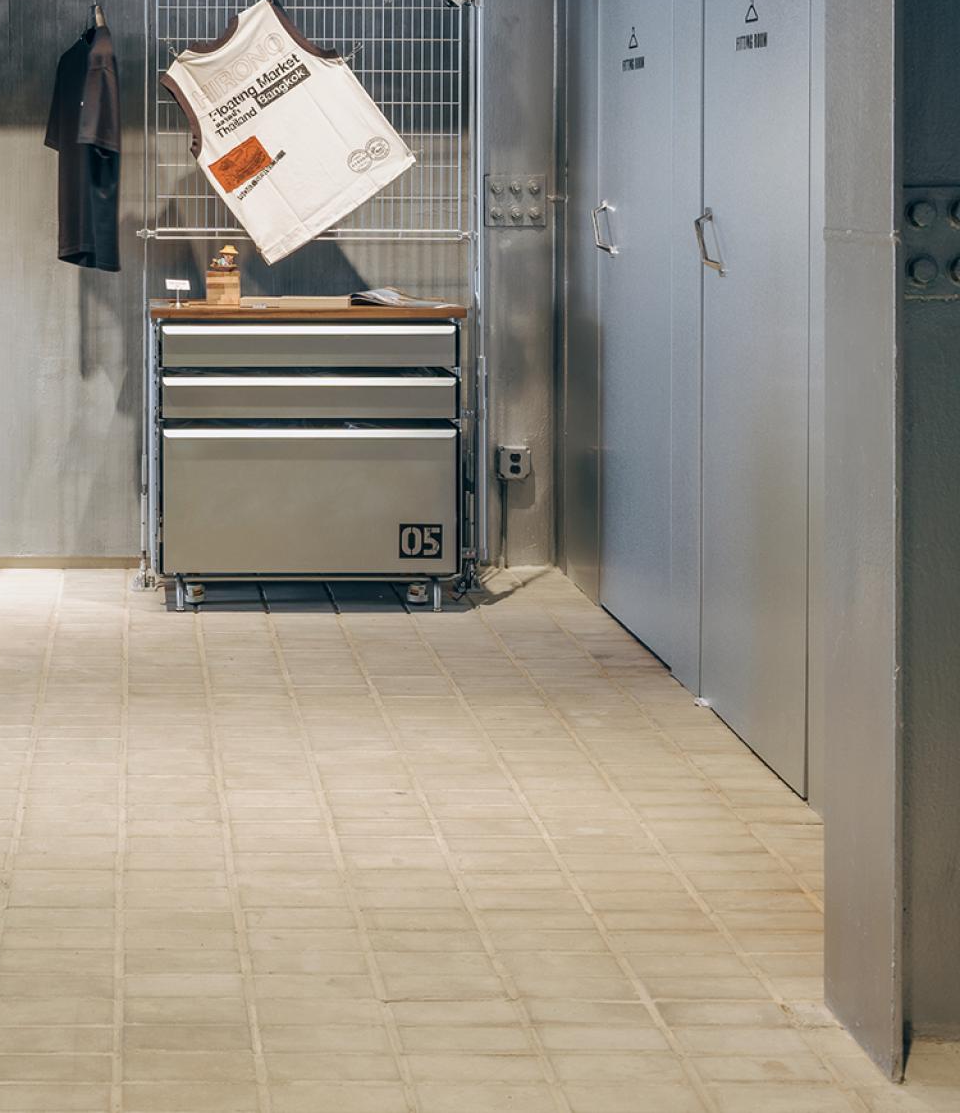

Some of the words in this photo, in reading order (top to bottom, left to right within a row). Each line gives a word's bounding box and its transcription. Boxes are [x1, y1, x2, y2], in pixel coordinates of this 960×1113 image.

[192, 32, 286, 111] HIRONO
[208, 85, 258, 122] Floating
[255, 53, 301, 89] Market
[258, 69, 307, 105] Bangkok
[214, 106, 258, 138] Thailand
[401, 526, 440, 556] 05
